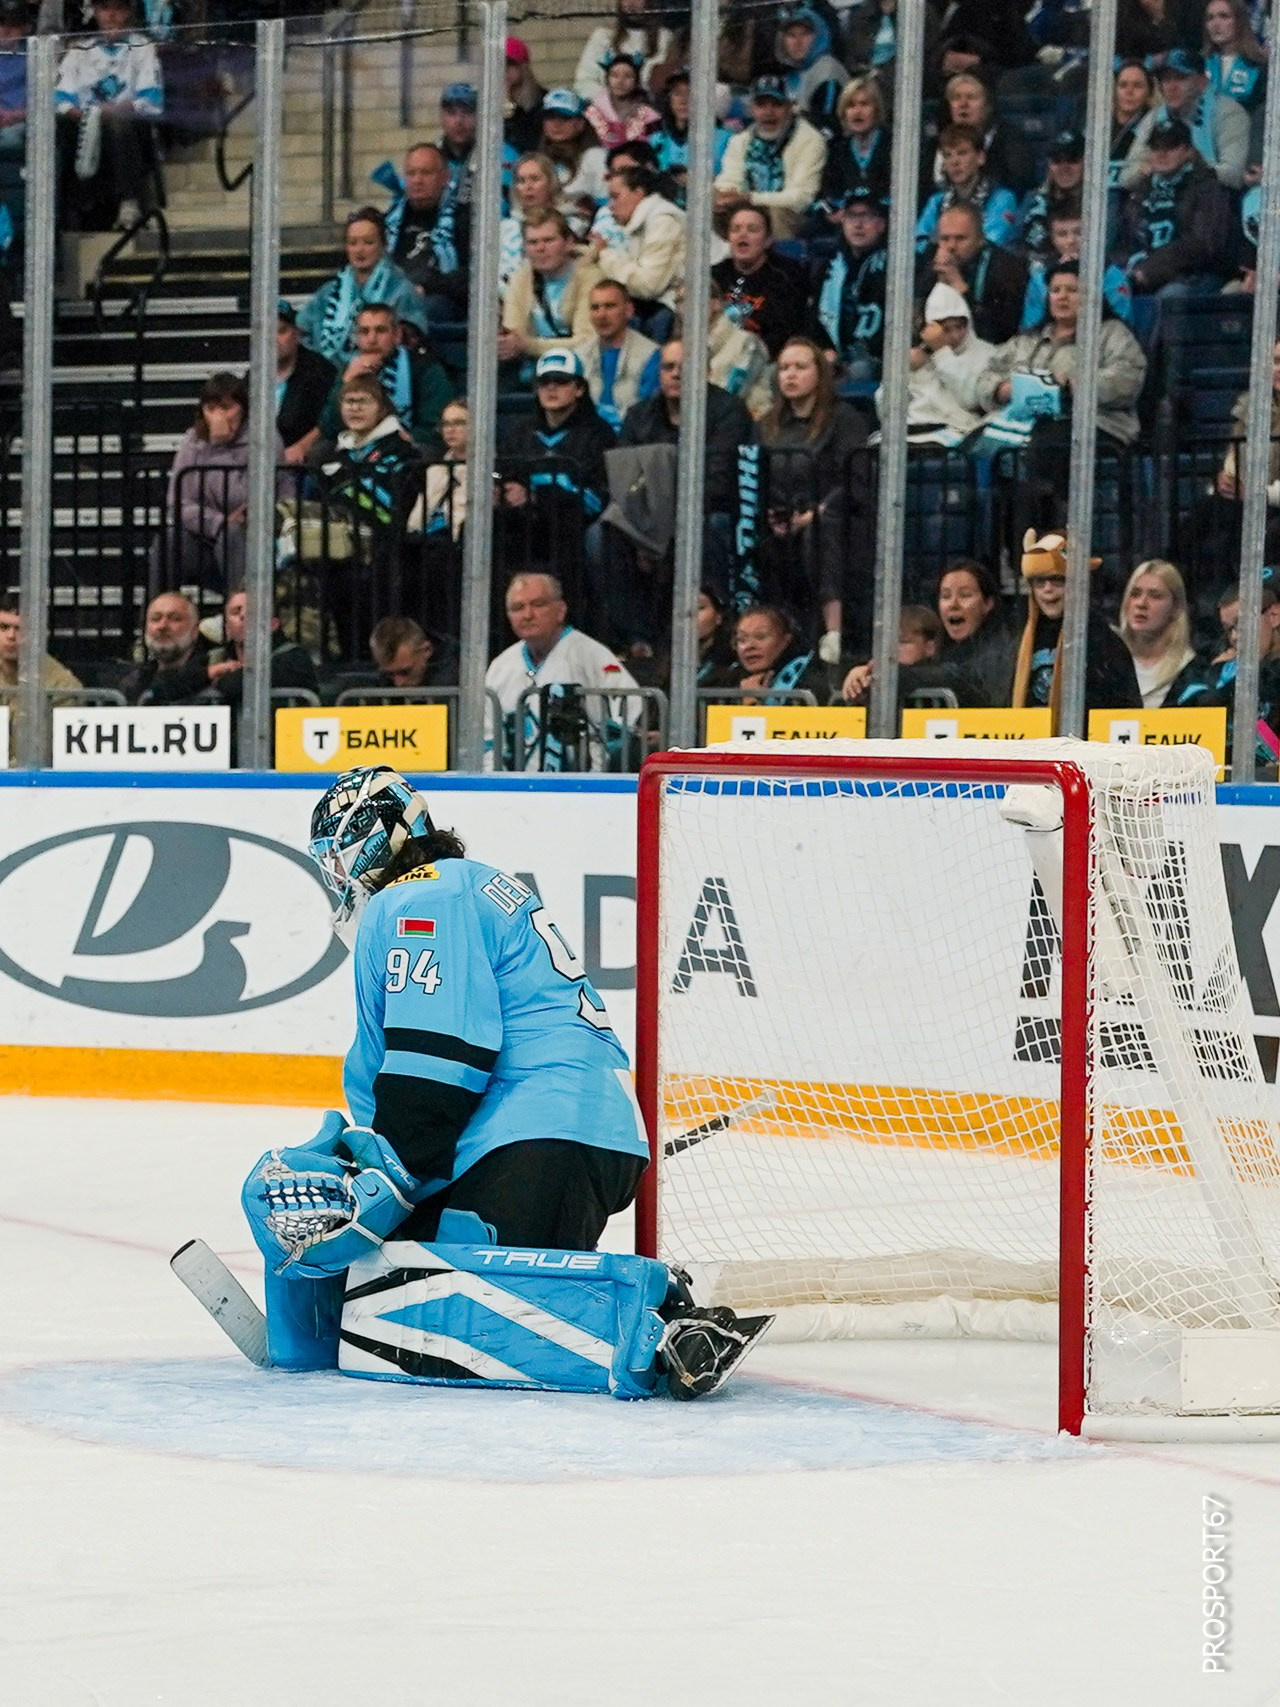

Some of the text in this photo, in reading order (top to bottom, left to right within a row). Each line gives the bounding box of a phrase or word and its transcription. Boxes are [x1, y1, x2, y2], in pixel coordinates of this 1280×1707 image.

[65, 722, 219, 755] KHL.RU
[346, 728, 418, 749] БАНК
[384, 947, 443, 996] 94
[472, 1249, 603, 1271] TRUE
